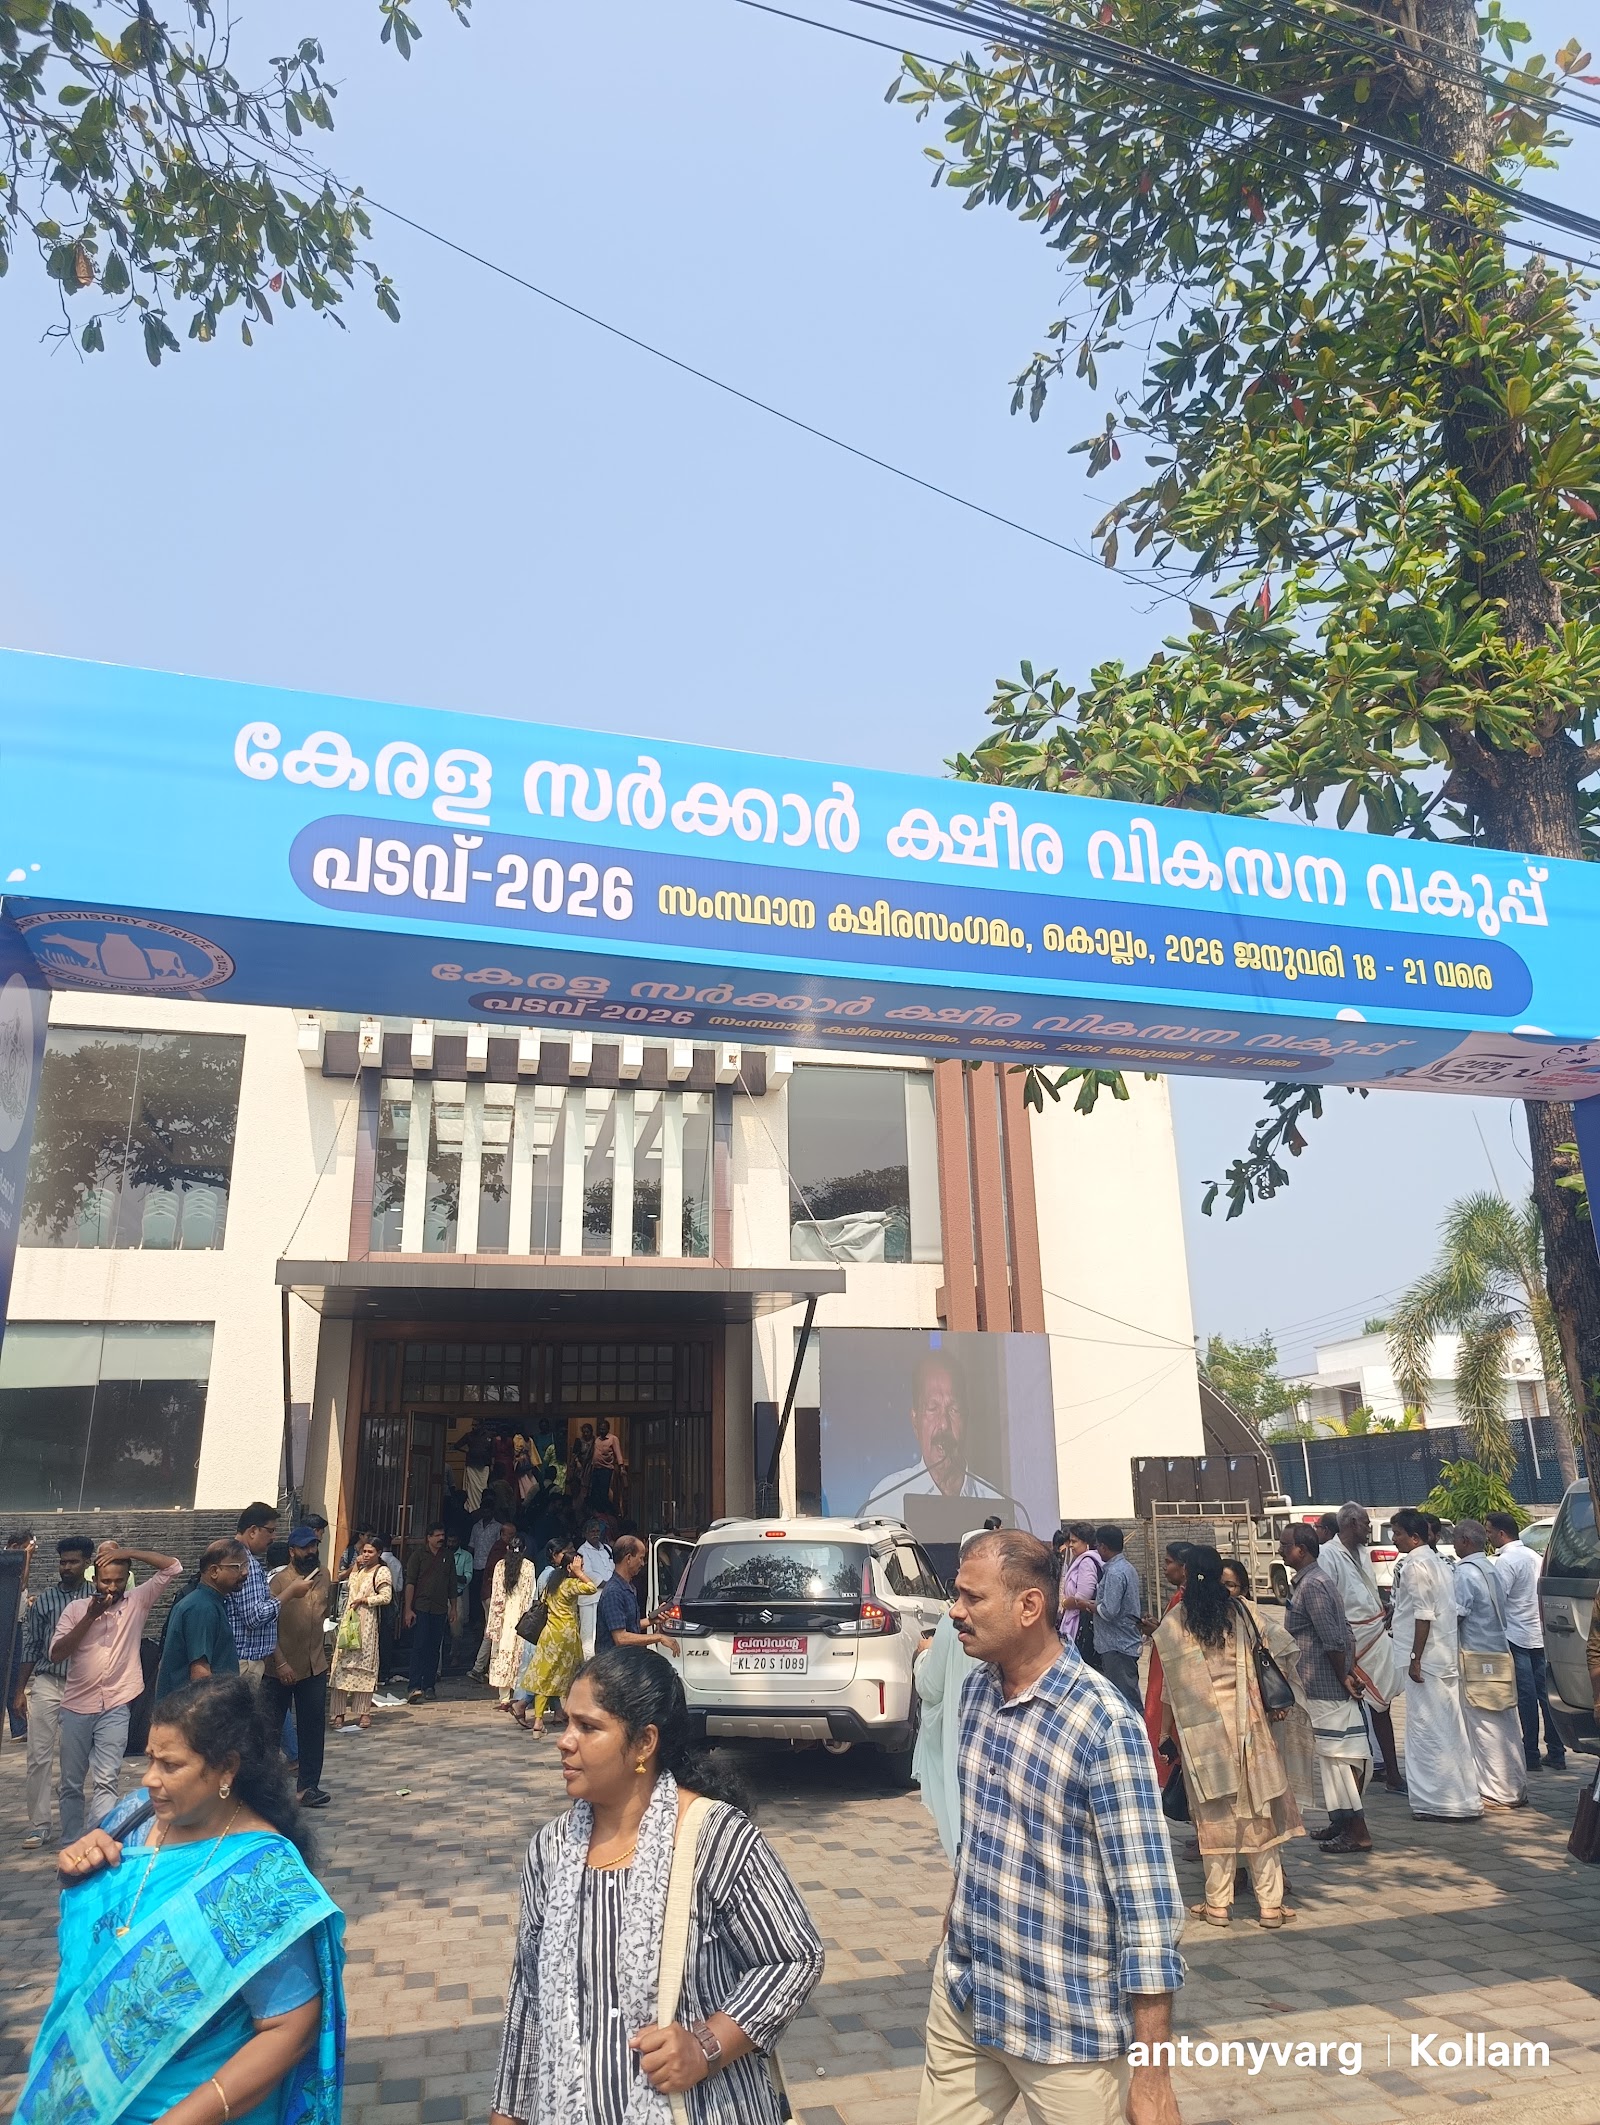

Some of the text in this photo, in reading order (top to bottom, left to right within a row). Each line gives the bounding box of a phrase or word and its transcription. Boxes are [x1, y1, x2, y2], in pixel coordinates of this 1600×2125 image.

[234, 721, 1549, 937] കേരള സർക്കാർ ക്ഷീര വികസന വകുപ്പ്
[16, 912, 214, 951] AIRY ADVISORY SERVICE
[312, 833, 634, 922] പടവ്-2026
[658, 884, 816, 929] സംസ്ഥാന
[828, 899, 1033, 954] ക്ഷീരസംഗമം,
[1043, 923, 1156, 965] കൊല്ലം,
[1165, 934, 1225, 966] 2026
[1233, 941, 1346, 981] ജനുവരി
[1352, 953, 1377, 981] 18
[1403, 958, 1428, 985] 21
[1433, 960, 1494, 991] വരെ
[66, 975, 107, 986] DAIRY
[110, 983, 198, 992] DEVELOPMENT
[431, 963, 1418, 1056] കേരള സർക്കാർ ക്ഷീര വികസന വകുപ്പ്
[483, 997, 695, 1025] പടവ്-2026
[1055, 1043, 1103, 1053] 2026
[1194, 1053, 1211, 1062] 18
[1229, 1056, 1248, 1065] 21
[1454, 1060, 1513, 1070] 2026
[738, 1657, 804, 1670] KL 20 S 1089
